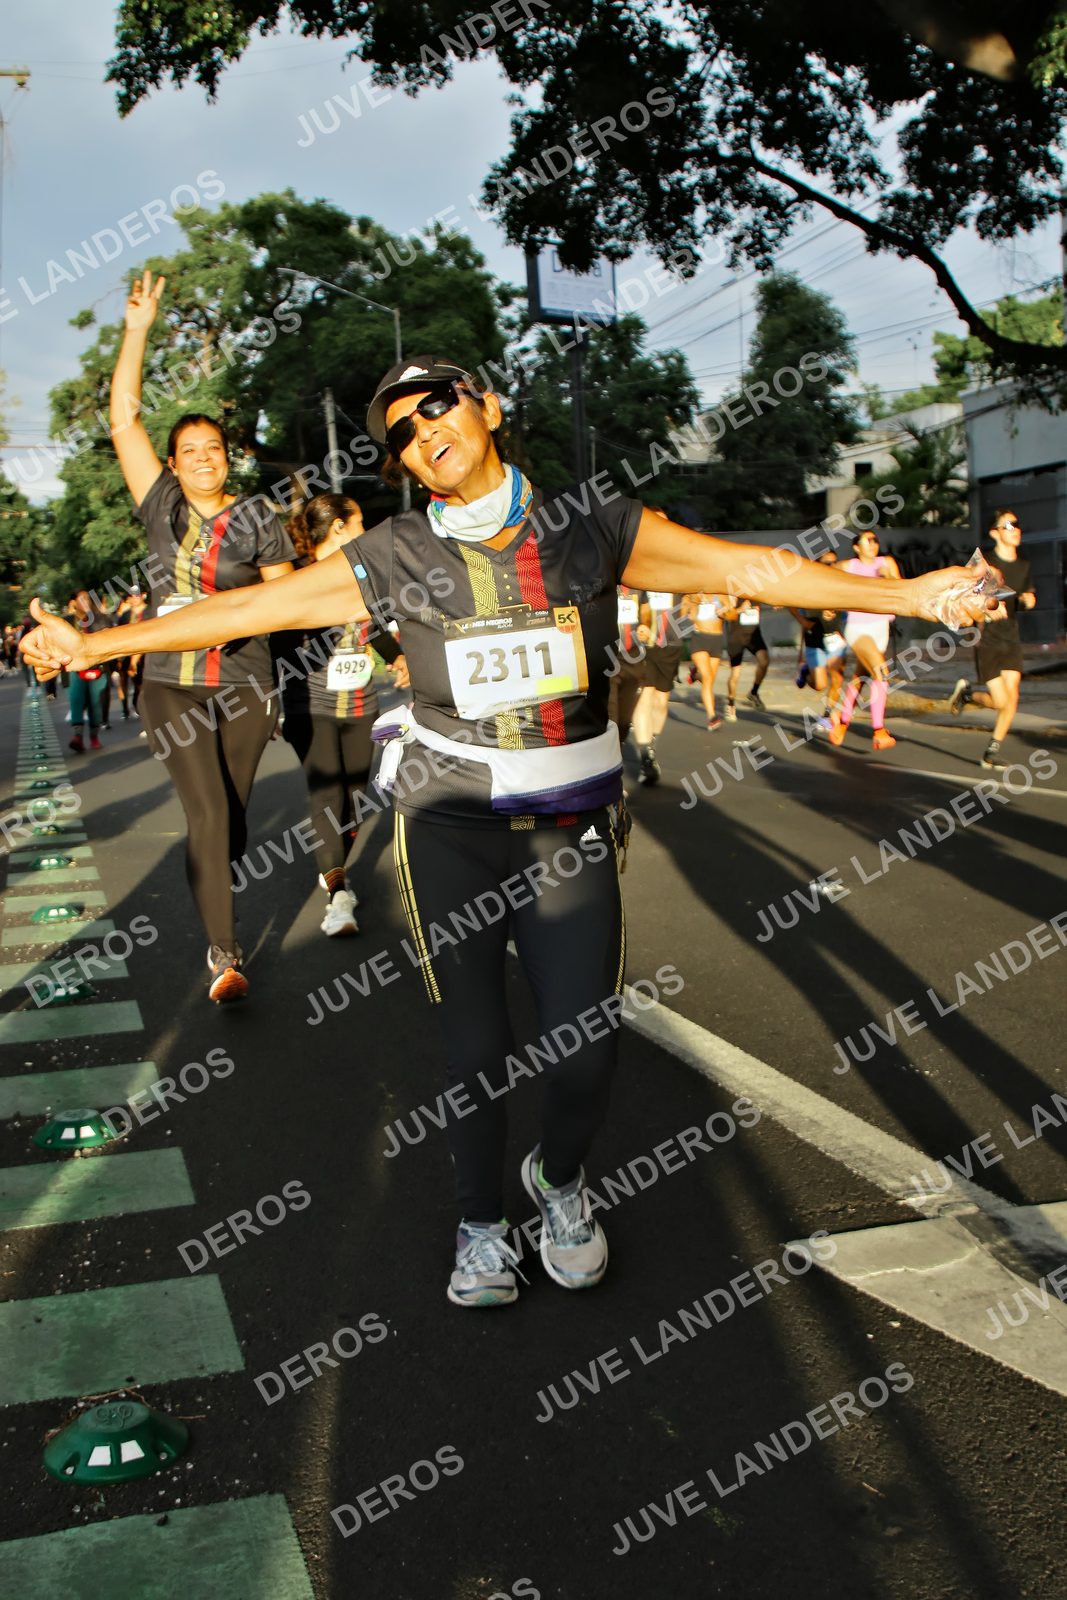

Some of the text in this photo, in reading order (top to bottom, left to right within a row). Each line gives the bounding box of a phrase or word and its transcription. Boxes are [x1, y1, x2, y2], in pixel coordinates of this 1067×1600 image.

[558, 610, 575, 624] 5K
[335, 660, 366, 674] 4929
[466, 641, 552, 685] 2311
